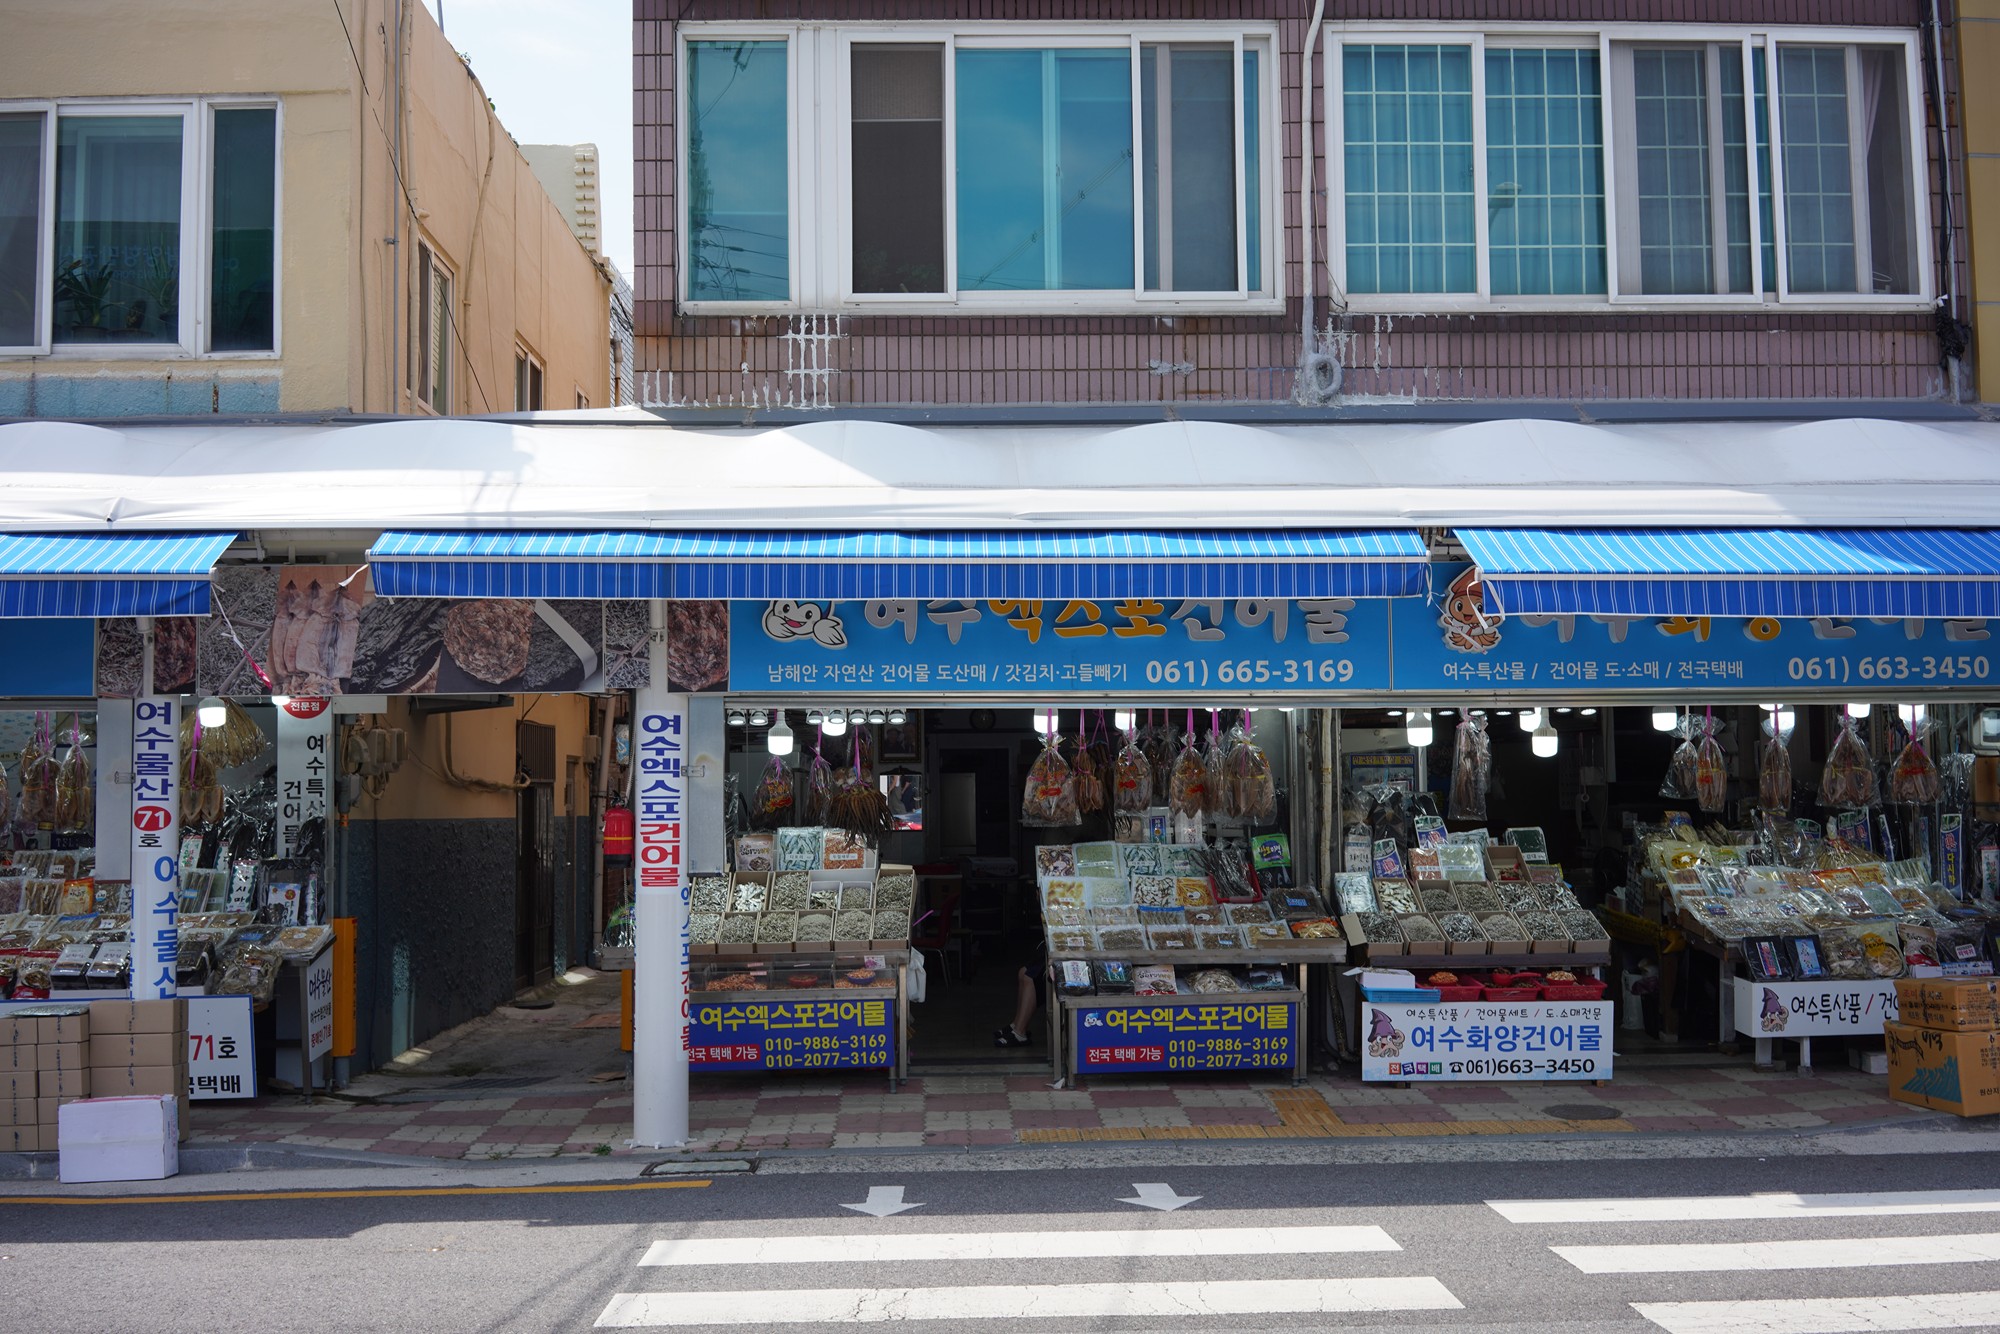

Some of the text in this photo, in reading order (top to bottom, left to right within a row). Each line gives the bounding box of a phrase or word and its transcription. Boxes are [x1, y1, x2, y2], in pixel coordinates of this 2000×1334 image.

[768, 664, 818, 683] 남해안
[824, 664, 874, 683] 자연산
[880, 664, 930, 683] 건어물
[936, 664, 986, 683] 도산매
[1005, 663, 1128, 683] 갓김치·고들빼기
[1145, 659, 1354, 686] 061) 665-3169
[1443, 662, 1526, 681] 여수특산물
[1550, 661, 1599, 680] 건어물
[1605, 661, 1659, 680] 도·소매
[1678, 660, 1744, 680] 전국택배
[1788, 656, 1990, 682] 061) 663-3450
[290, 702, 320, 712] 전문점
[134, 701, 173, 801] 여수물산
[640, 714, 681, 887] 여수엑스포건어물
[699, 1001, 886, 1032] 여수엑스포건어물
[1406, 1008, 1459, 1022] 여수특산품
[1476, 1008, 1529, 1022] 건어물세트
[1791, 993, 1862, 1024] 여수특산품
[1105, 1004, 1289, 1034] 여수엑스포건어물
[190, 1035, 238, 1061] 71호
[765, 1034, 887, 1052] 010-9886-3169
[1169, 1036, 1289, 1053] 010-9886-3169
[1411, 1025, 1602, 1052] 여수화양건어물
[710, 1047, 732, 1061] 택배
[736, 1046, 758, 1060] 가능
[765, 1051, 887, 1068] 010-2077-3169
[1088, 1047, 1162, 1062] 전국 택배 가능
[1169, 1052, 1288, 1069] 010-2077-3169
[1389, 1062, 1442, 1075] 전국택배
[1466, 1058, 1595, 1076] 061)663-3450
